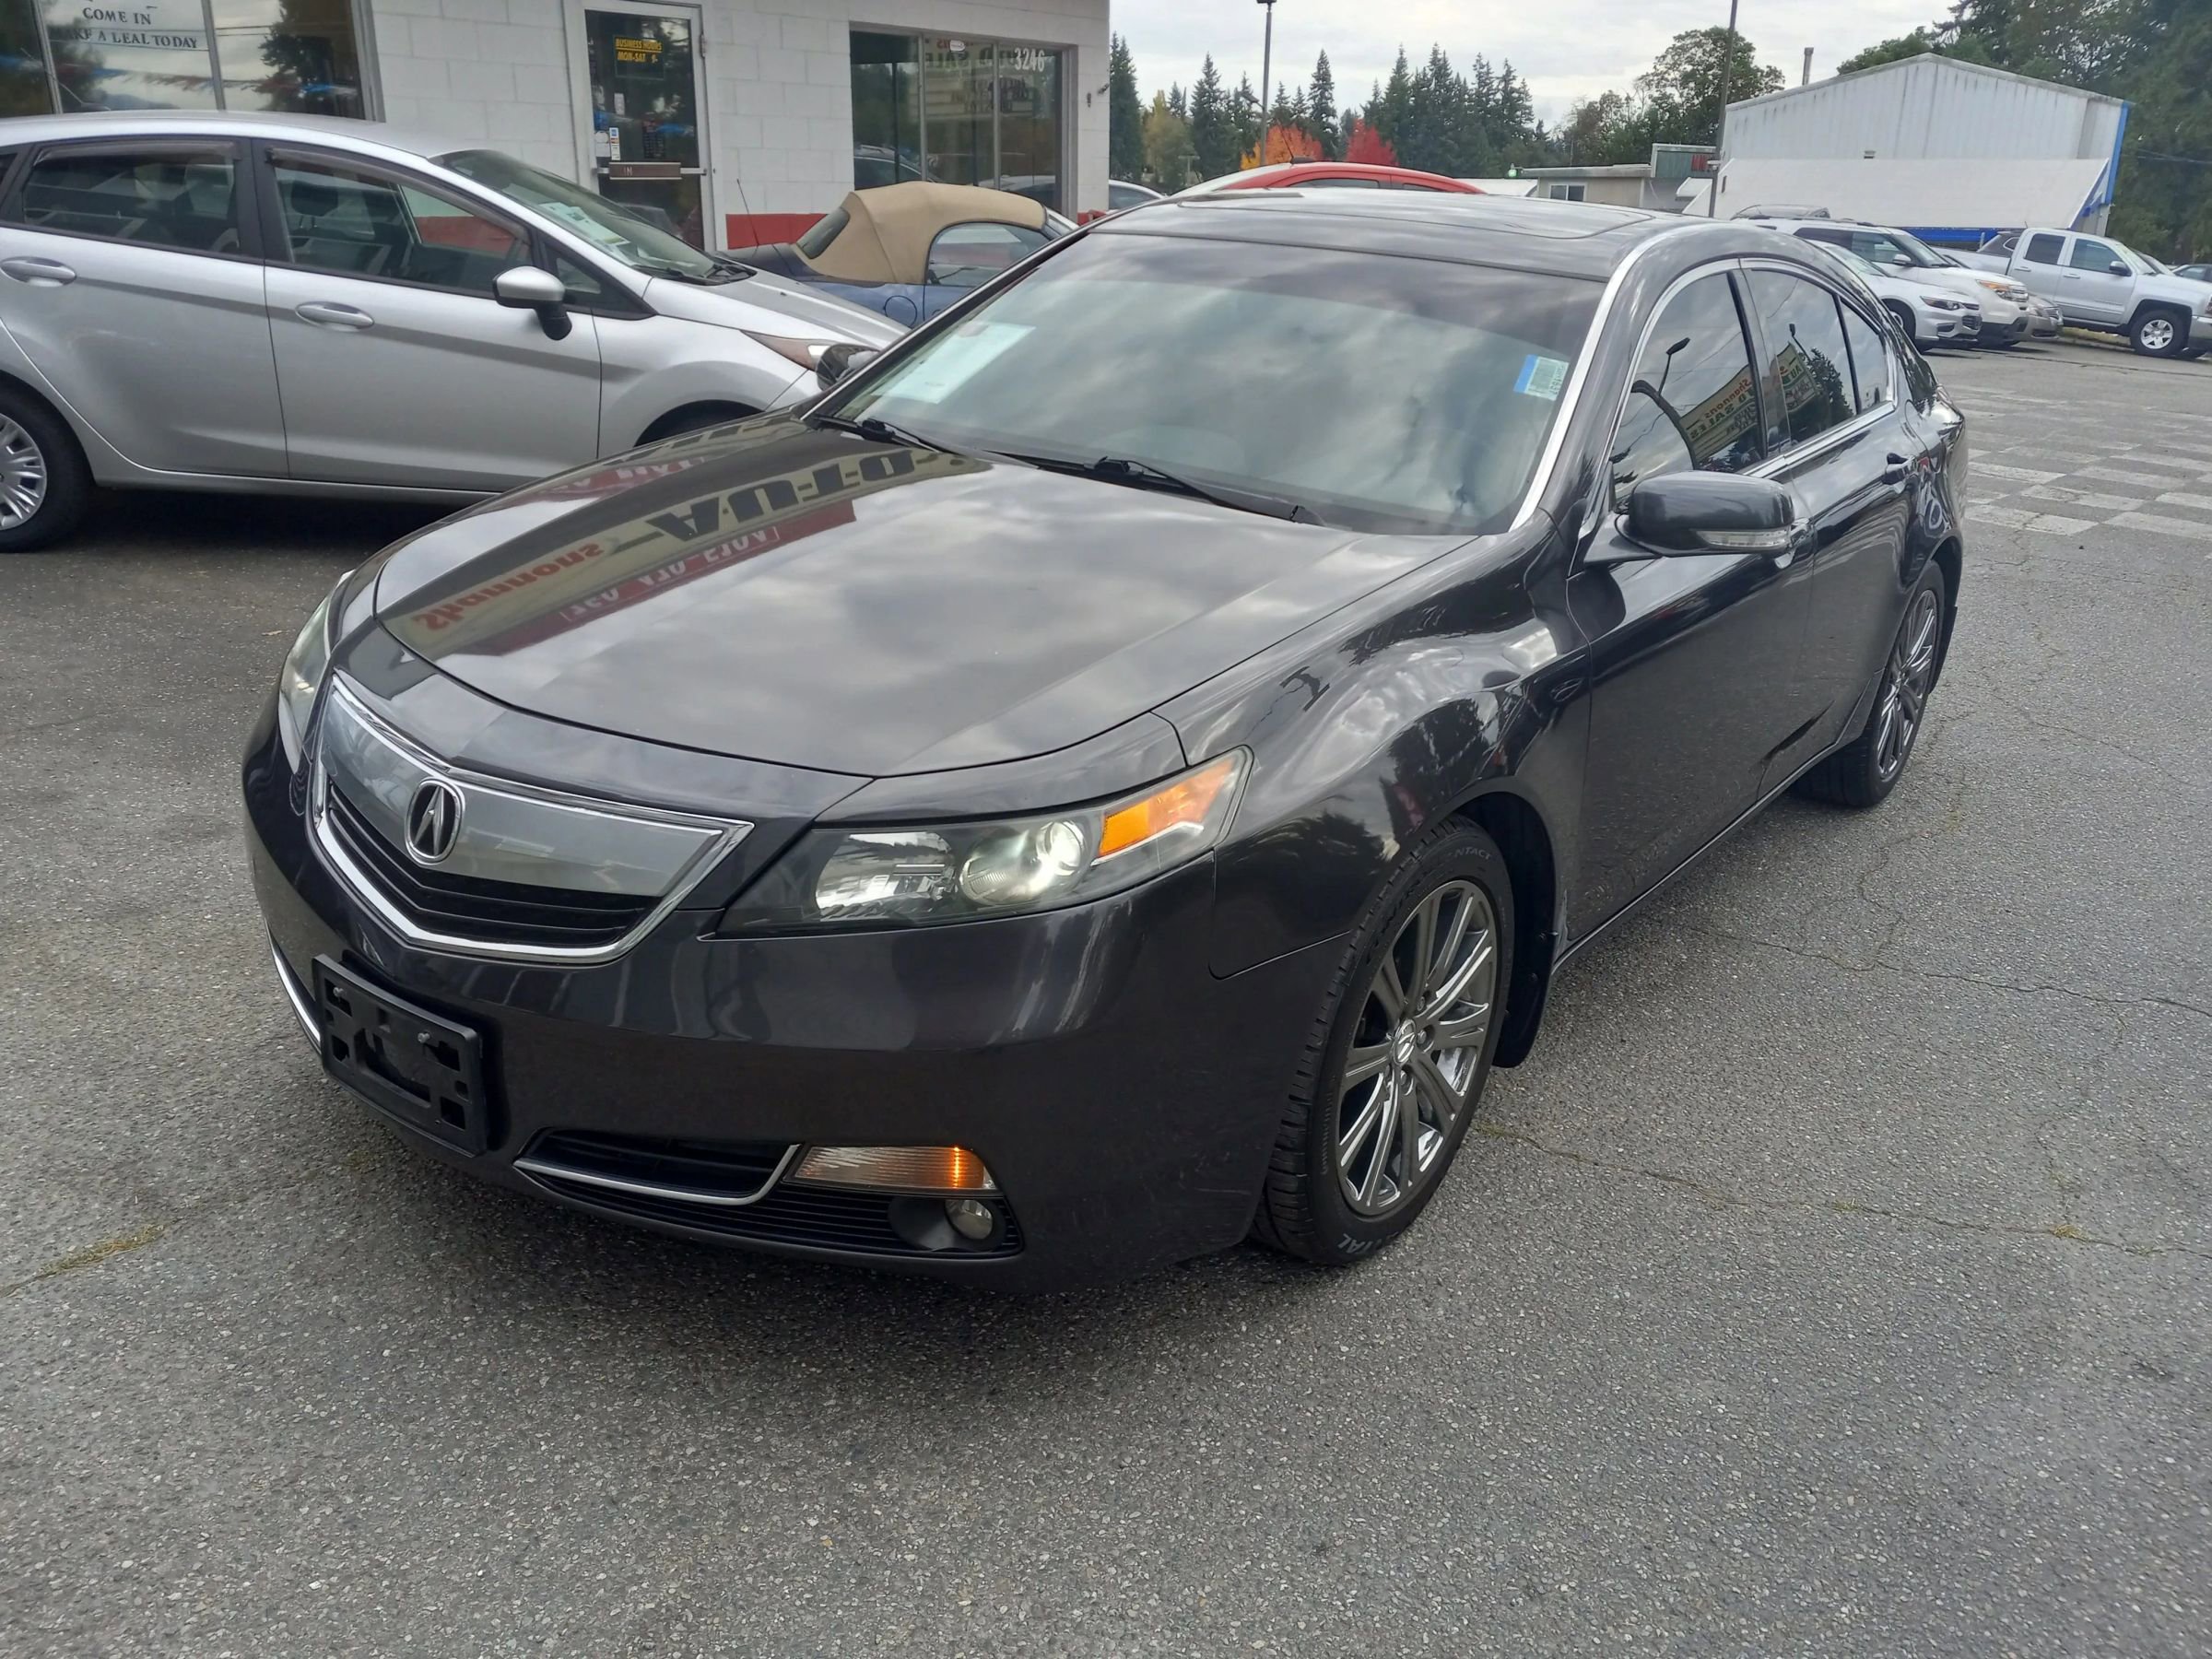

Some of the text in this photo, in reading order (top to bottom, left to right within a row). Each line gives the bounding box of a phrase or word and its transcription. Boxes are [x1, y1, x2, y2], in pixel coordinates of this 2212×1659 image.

[82, 6, 151, 25] COME IN
[98, 30, 107, 41] A
[152, 34, 197, 49] TODAY
[615, 37, 642, 49] BUSINESS
[1014, 47, 1045, 72] 3246
